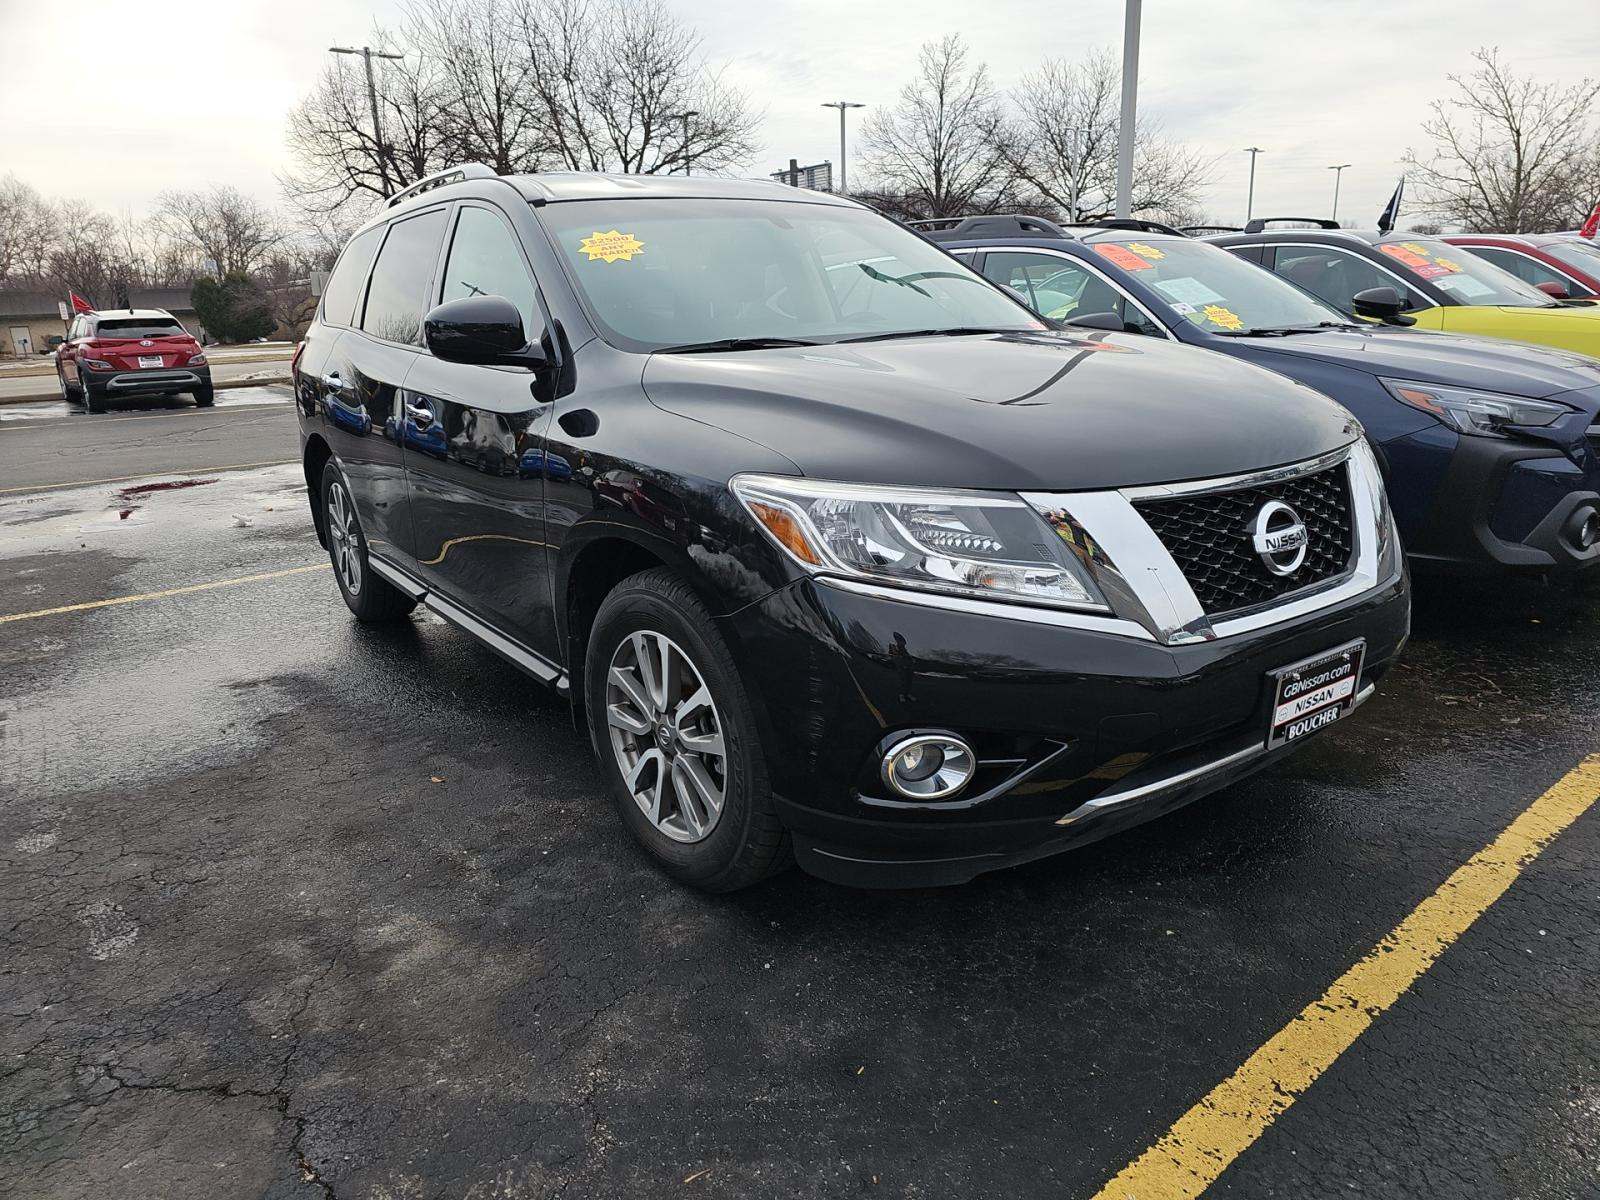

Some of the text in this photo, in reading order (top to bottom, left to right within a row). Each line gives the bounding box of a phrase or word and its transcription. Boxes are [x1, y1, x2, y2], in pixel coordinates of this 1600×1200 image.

[1265, 528, 1306, 550] NISSAN
[1294, 688, 1334, 714] NISSAN
[1288, 707, 1338, 739] BOUCHER
